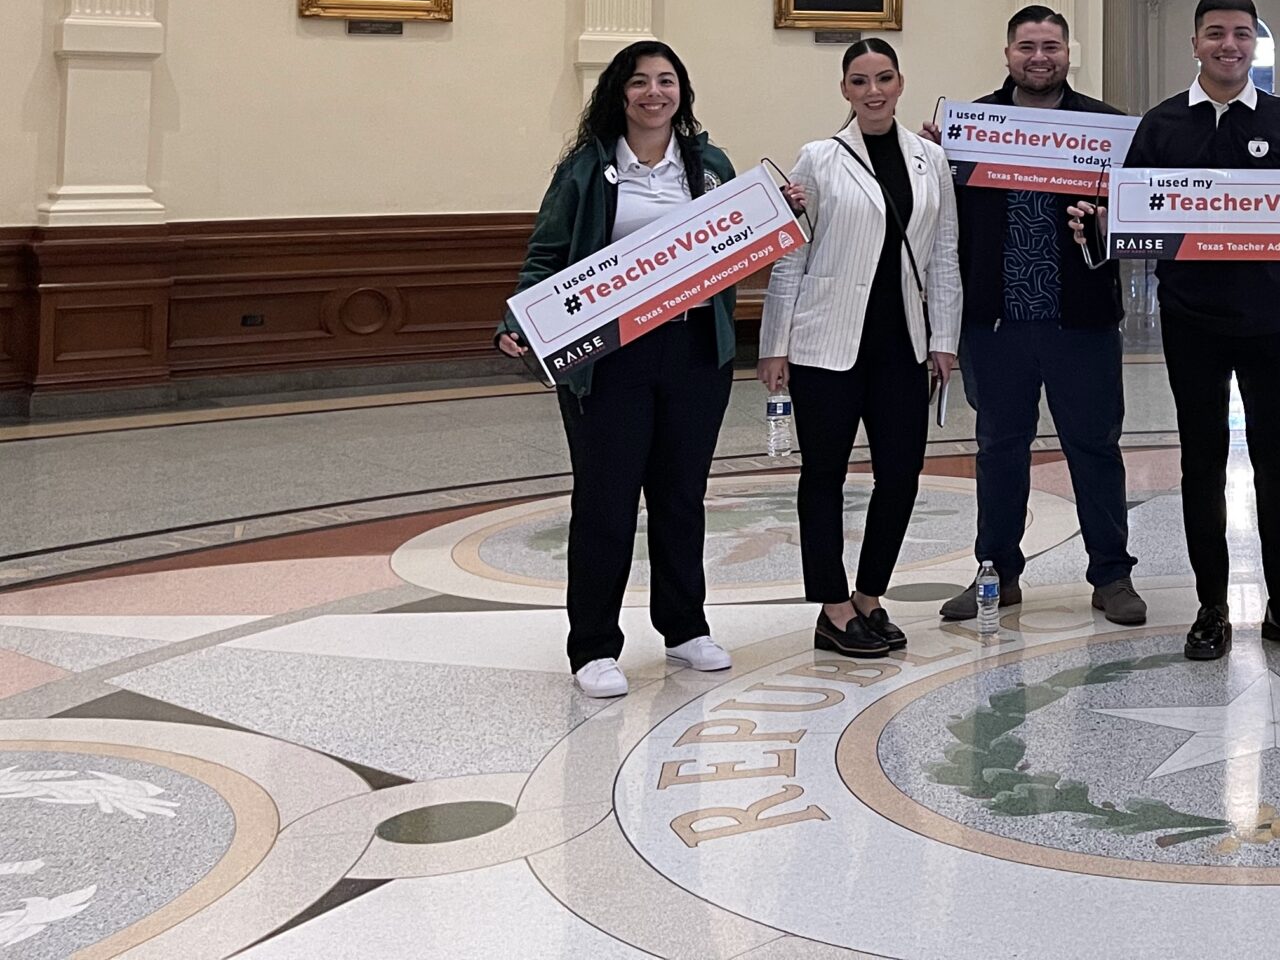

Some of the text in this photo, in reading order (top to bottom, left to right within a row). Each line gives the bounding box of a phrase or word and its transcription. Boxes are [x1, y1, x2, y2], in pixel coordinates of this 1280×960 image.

[949, 110, 1007, 124] I used my
[947, 124, 1112, 153] #TeacherVoice
[1073, 154, 1111, 167] today!
[987, 171, 1011, 181] Texas
[1013, 173, 1047, 184] Teacher
[1049, 175, 1093, 188] Advocacy
[1149, 178, 1213, 189] I used my
[711, 226, 754, 254] today!
[1116, 238, 1163, 249] RAISE
[1197, 242, 1224, 252] Texas
[1226, 242, 1264, 252] Teacher
[553, 254, 619, 295] I used my
[563, 210, 744, 315] #TeacherVoice
[634, 244, 774, 326] Texas Teacher Advocacy Days
[553, 335, 604, 369] RAISE
[656, 605, 1096, 849] REPUBLIC
